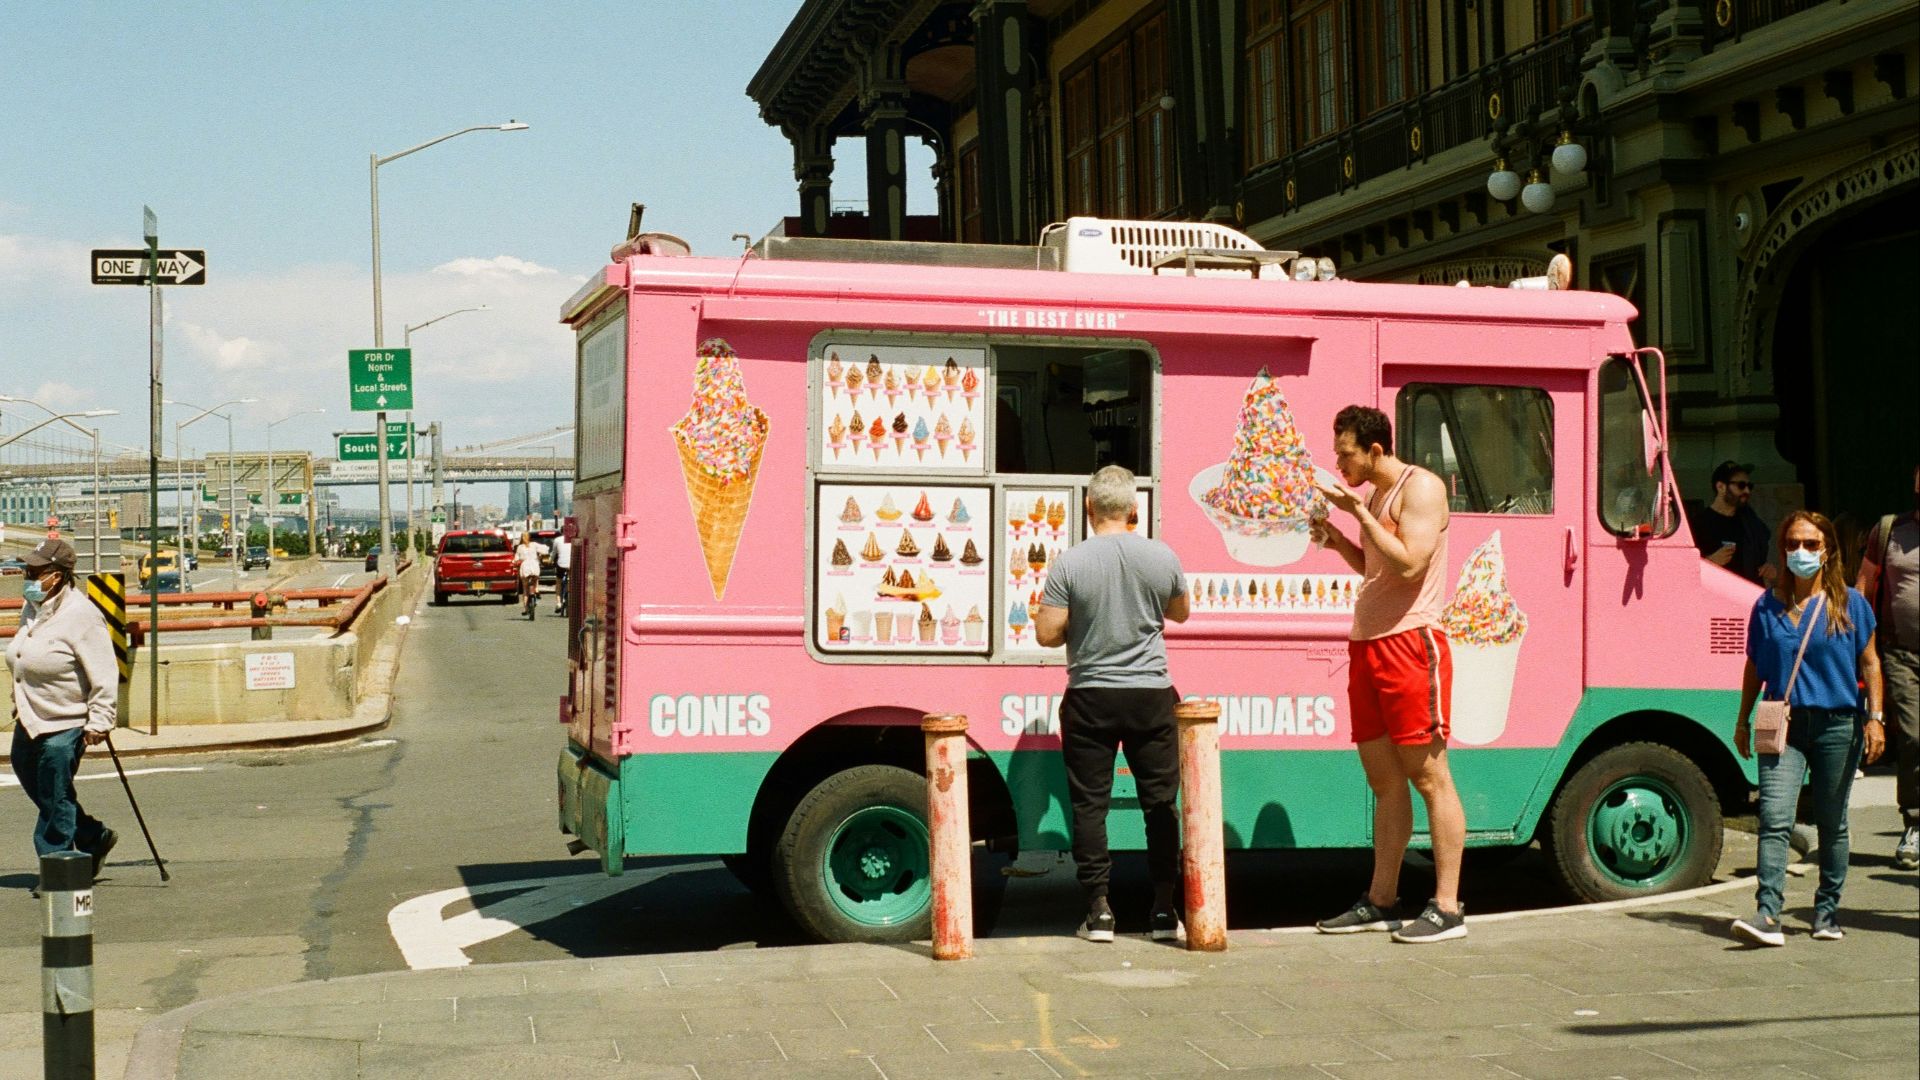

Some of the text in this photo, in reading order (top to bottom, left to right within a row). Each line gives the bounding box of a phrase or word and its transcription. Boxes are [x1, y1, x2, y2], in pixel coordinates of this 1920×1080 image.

[101, 260, 134, 274] ONE
[1025, 311, 1068, 328] BEST
[364, 353, 395, 362] FDR Dr
[368, 363, 393, 372] NORTH
[377, 373, 385, 382] &
[354, 383, 407, 393] Local Streets
[344, 443, 377, 453] South
[649, 693, 771, 737] CONES
[1001, 693, 1336, 736] SHA UNDAES
